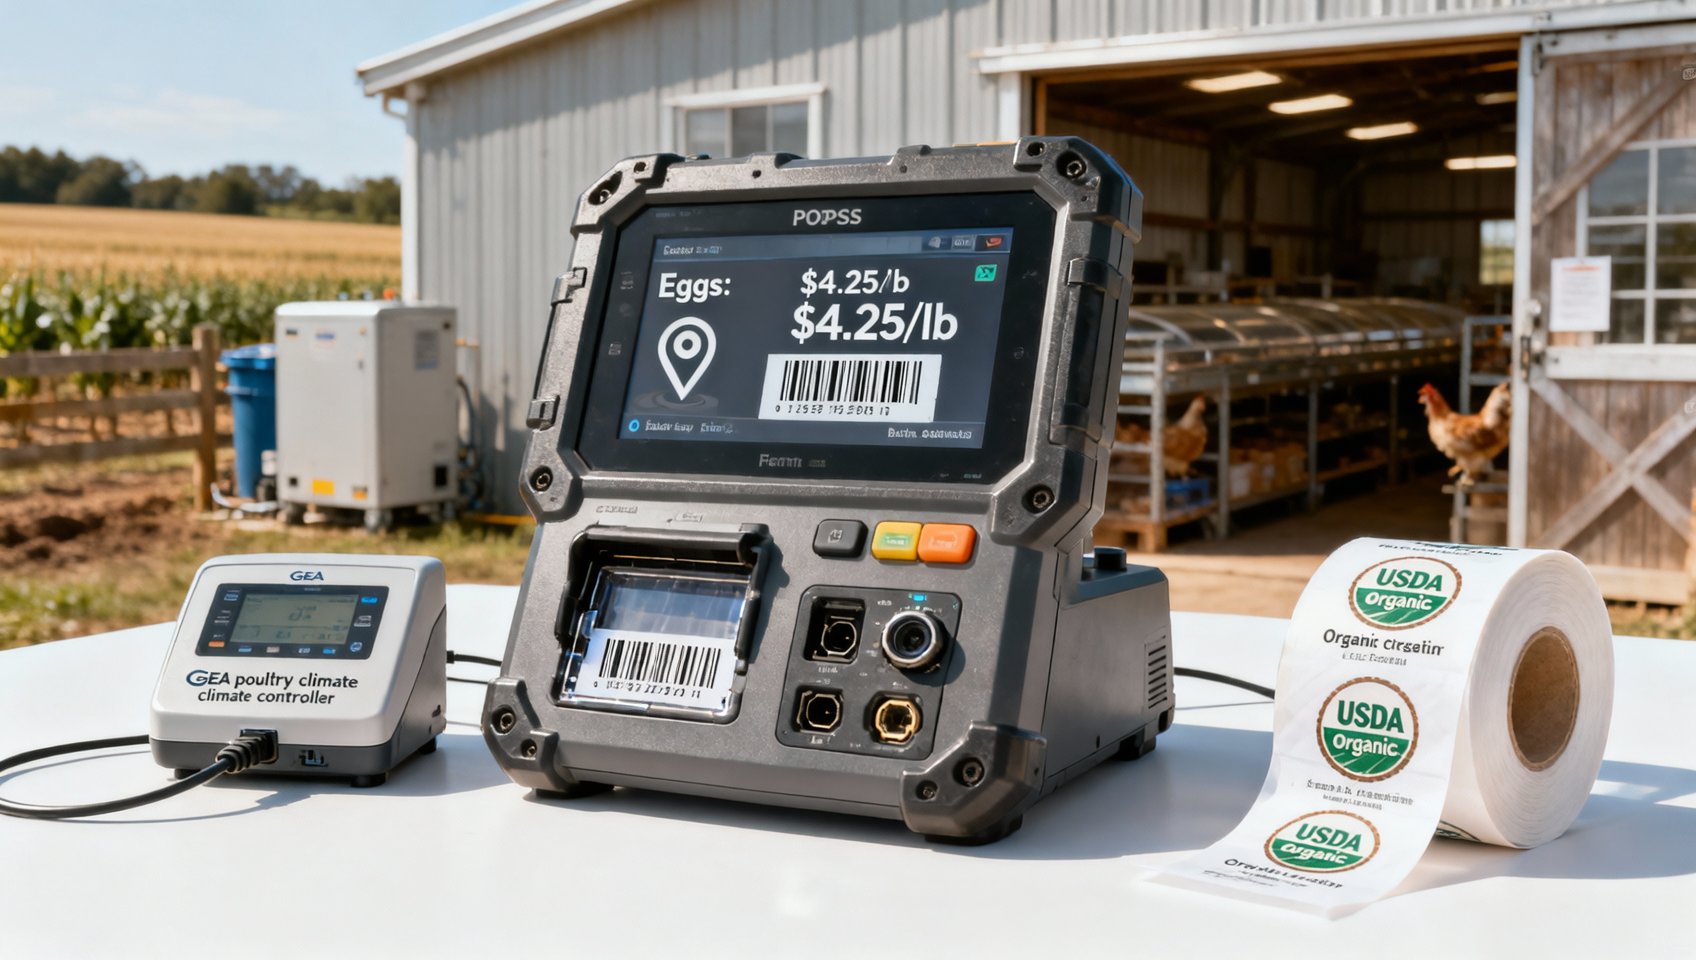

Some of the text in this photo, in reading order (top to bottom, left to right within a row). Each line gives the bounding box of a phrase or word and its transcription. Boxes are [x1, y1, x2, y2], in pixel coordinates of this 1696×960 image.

[658, 272, 731, 304] Eggs:
[791, 301, 958, 344] $4.25/lb
[290, 571, 324, 581] GEA
[1376, 567, 1443, 592] USDA
[186, 669, 358, 690] GEA poultry climate
[197, 688, 335, 705] climate controller
[1337, 700, 1404, 734] USDA
[1332, 733, 1398, 757] Organic
[1295, 822, 1362, 852] USDA
